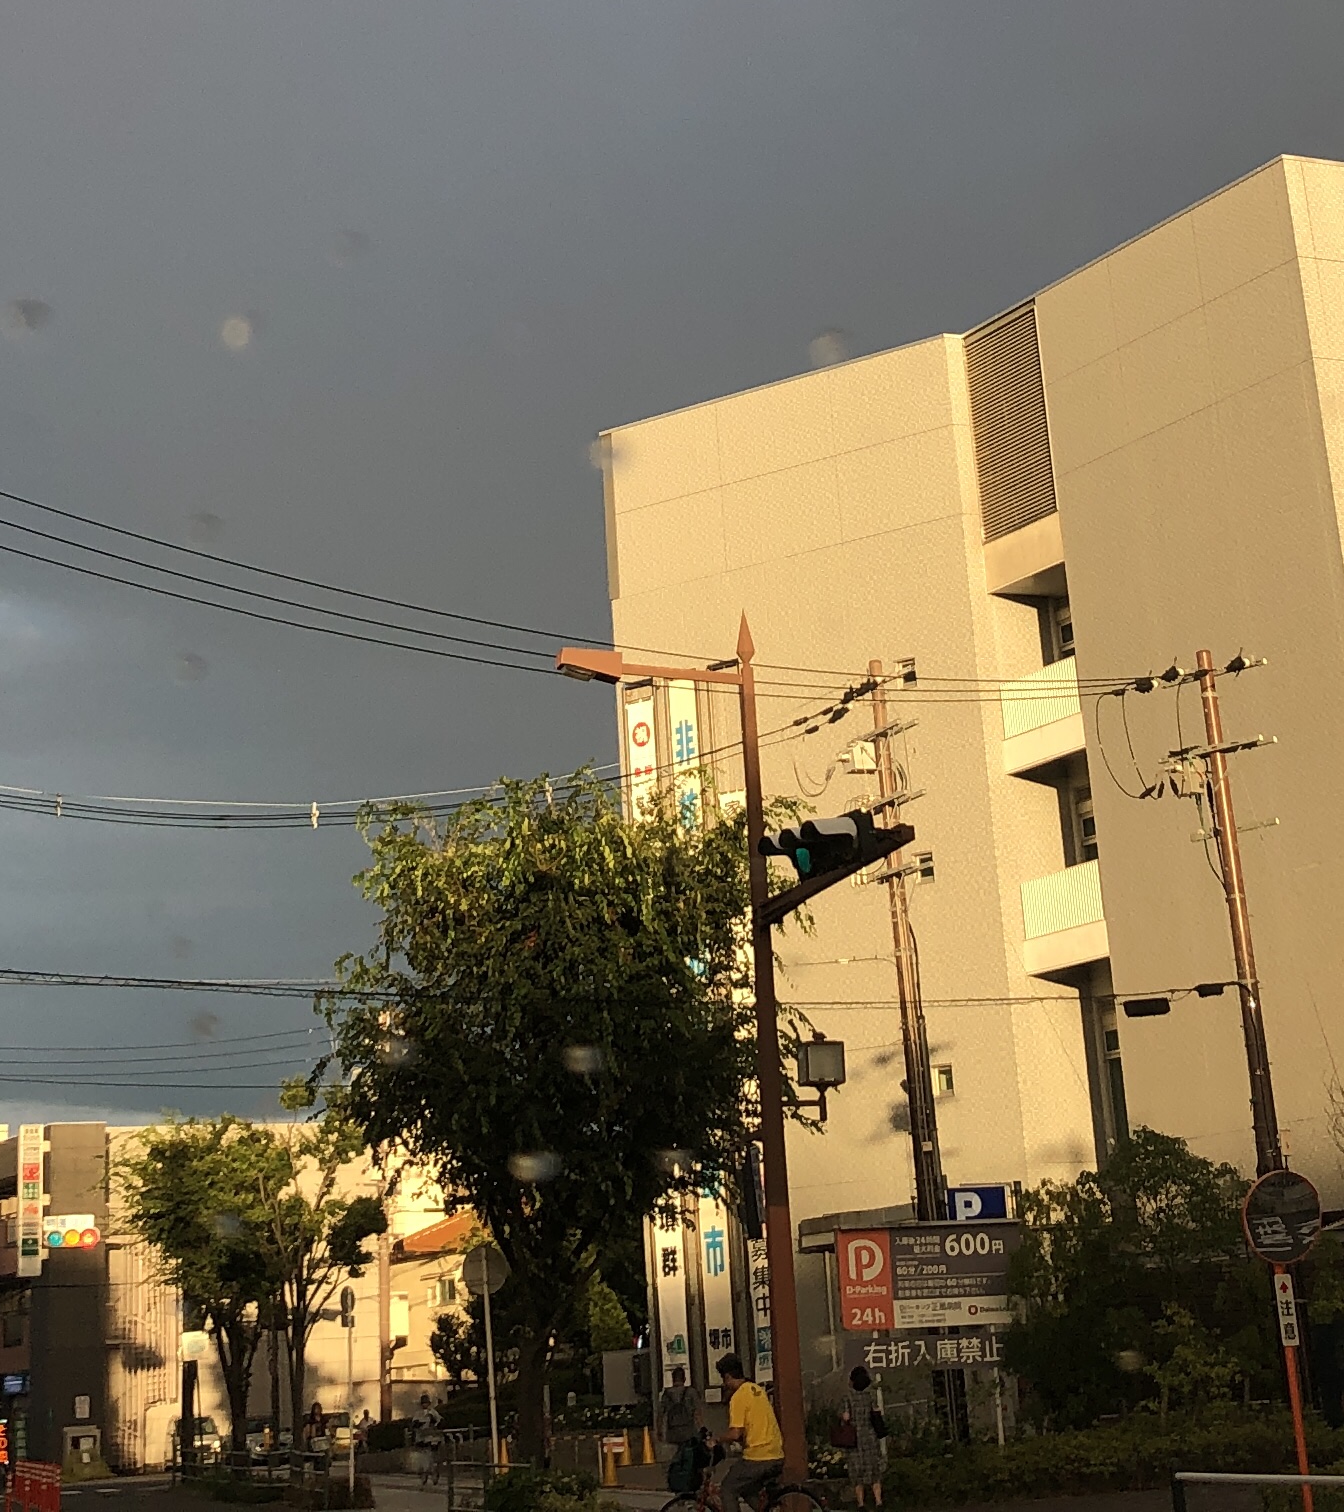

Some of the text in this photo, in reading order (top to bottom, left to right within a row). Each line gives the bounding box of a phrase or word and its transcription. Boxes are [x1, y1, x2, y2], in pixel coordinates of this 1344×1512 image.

[955, 1191, 982, 1221] P
[703, 1225, 725, 1277] 市
[944, 1232, 1004, 1257] 600円
[846, 1284, 887, 1296] D-Parking
[851, 1307, 886, 1325] 24h
[1278, 1299, 1297, 1341] 注意
[863, 1335, 1004, 1369] 右折入庫禁止
